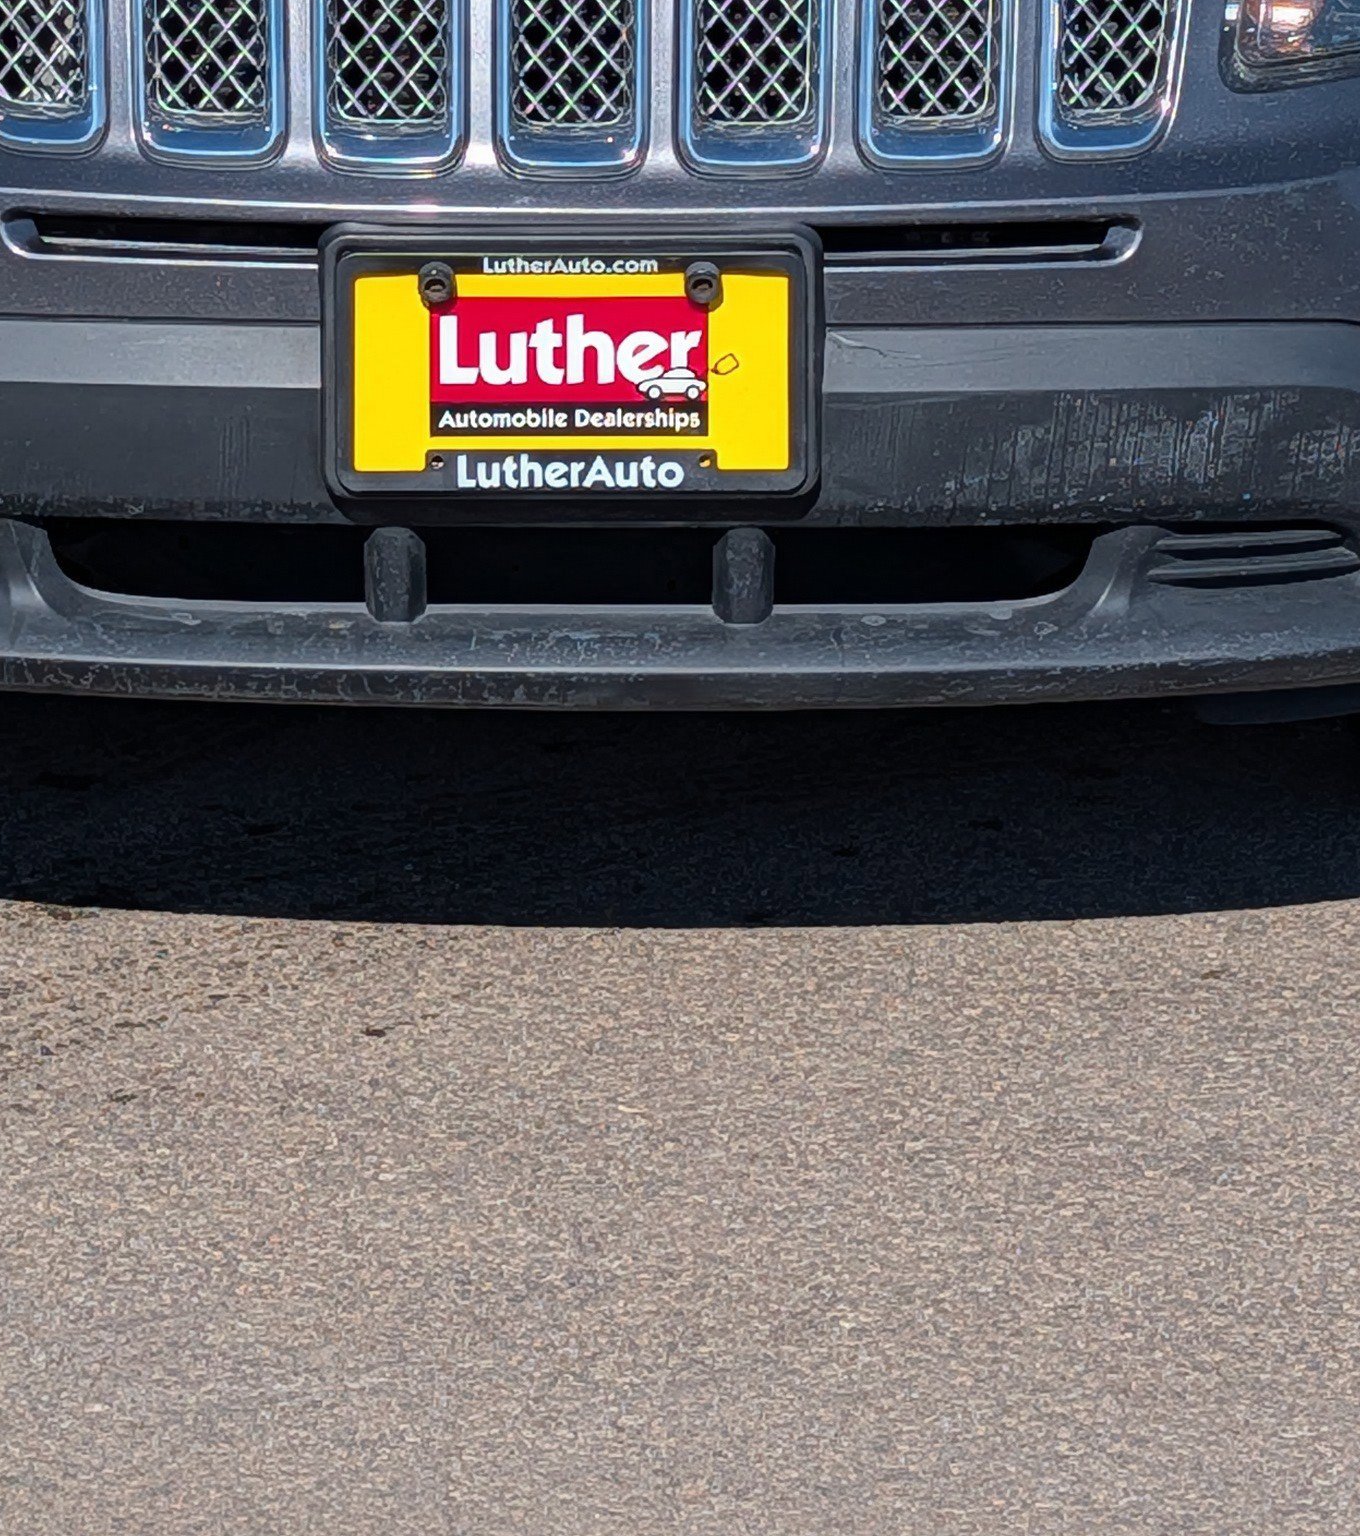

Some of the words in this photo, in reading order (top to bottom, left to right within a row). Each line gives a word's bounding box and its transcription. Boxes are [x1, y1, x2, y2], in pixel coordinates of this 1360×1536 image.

[482, 257, 659, 274] LutherAuto.com
[439, 313, 703, 385] Luther
[438, 408, 568, 429] Automobile
[574, 408, 701, 432] Dealerships
[456, 454, 685, 489] LutherAuto
